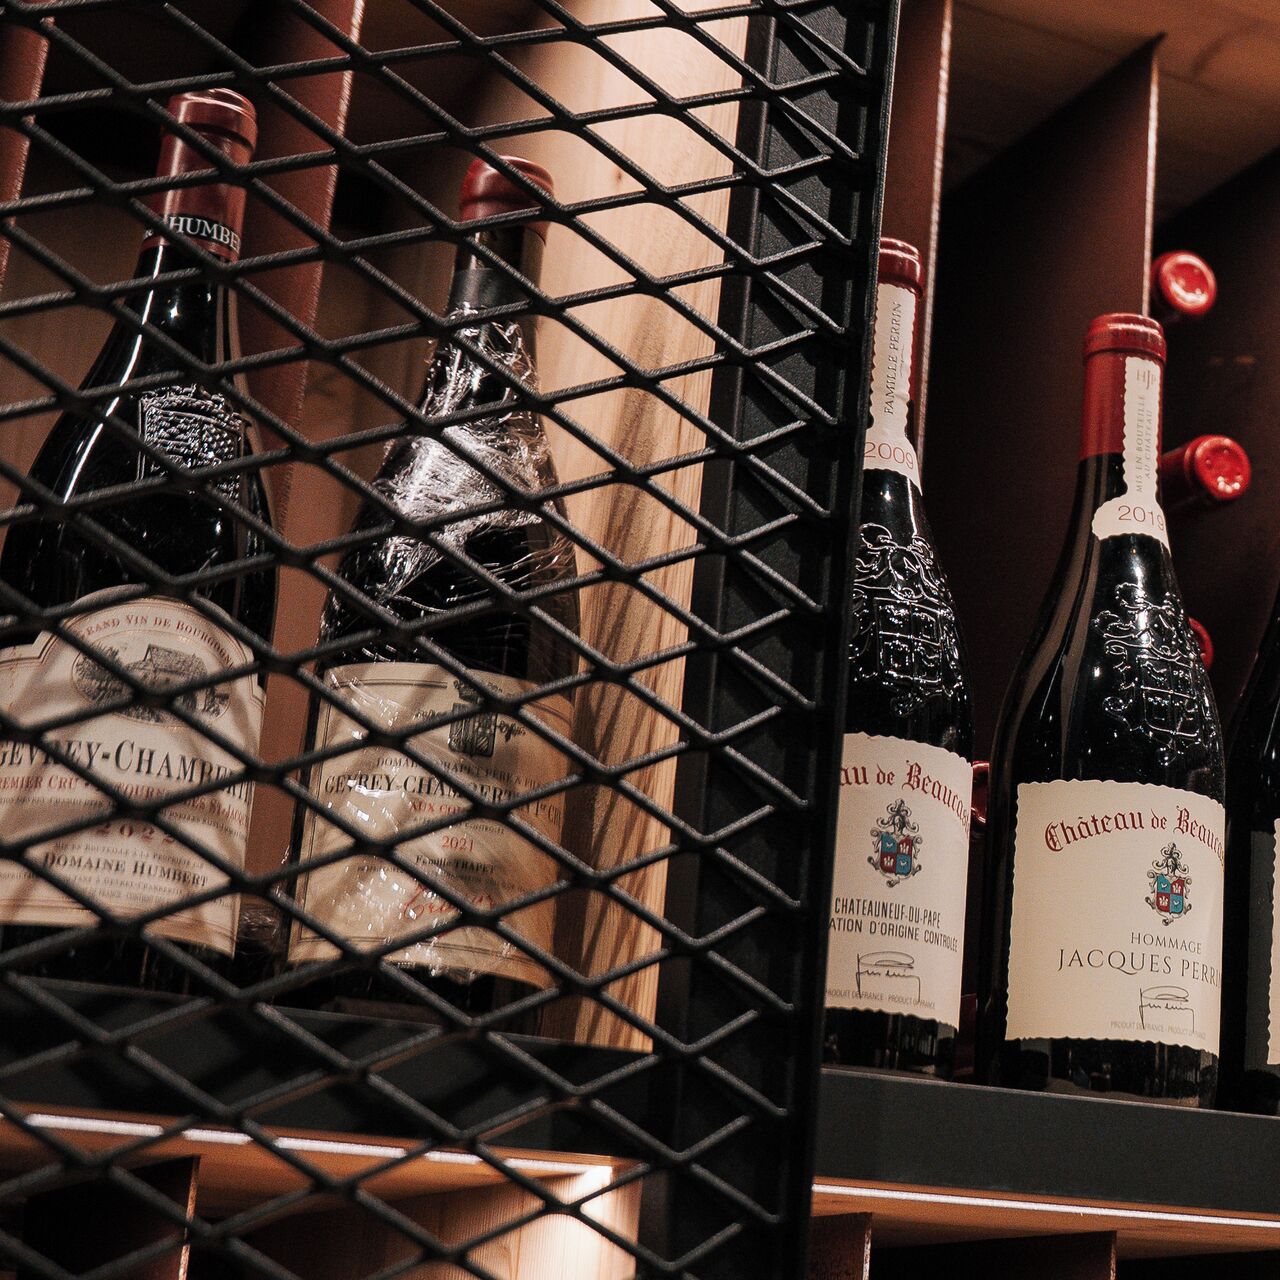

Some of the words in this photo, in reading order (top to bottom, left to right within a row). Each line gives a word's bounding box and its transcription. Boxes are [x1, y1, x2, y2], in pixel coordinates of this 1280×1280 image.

[169, 216, 241, 255] HUMBE
[889, 302, 902, 352] PERRIN
[883, 356, 899, 415] FAMILLE
[863, 441, 915, 470] 2009
[176, 620, 236, 671] BOURGOGN
[876, 763, 896, 786] de
[442, 835, 475, 852] 2021
[1045, 810, 1145, 852] Château
[1150, 808, 1168, 830] de
[43, 852, 126, 873] DOMAINE
[133, 861, 208, 887] HUMBERT
[834, 897, 942, 929] CHATEAUNEUF-DU-PAPE
[869, 920, 920, 941] D'ORIGINE
[1130, 931, 1202, 955] HOMMAGE
[1057, 948, 1172, 976] JACQUES
